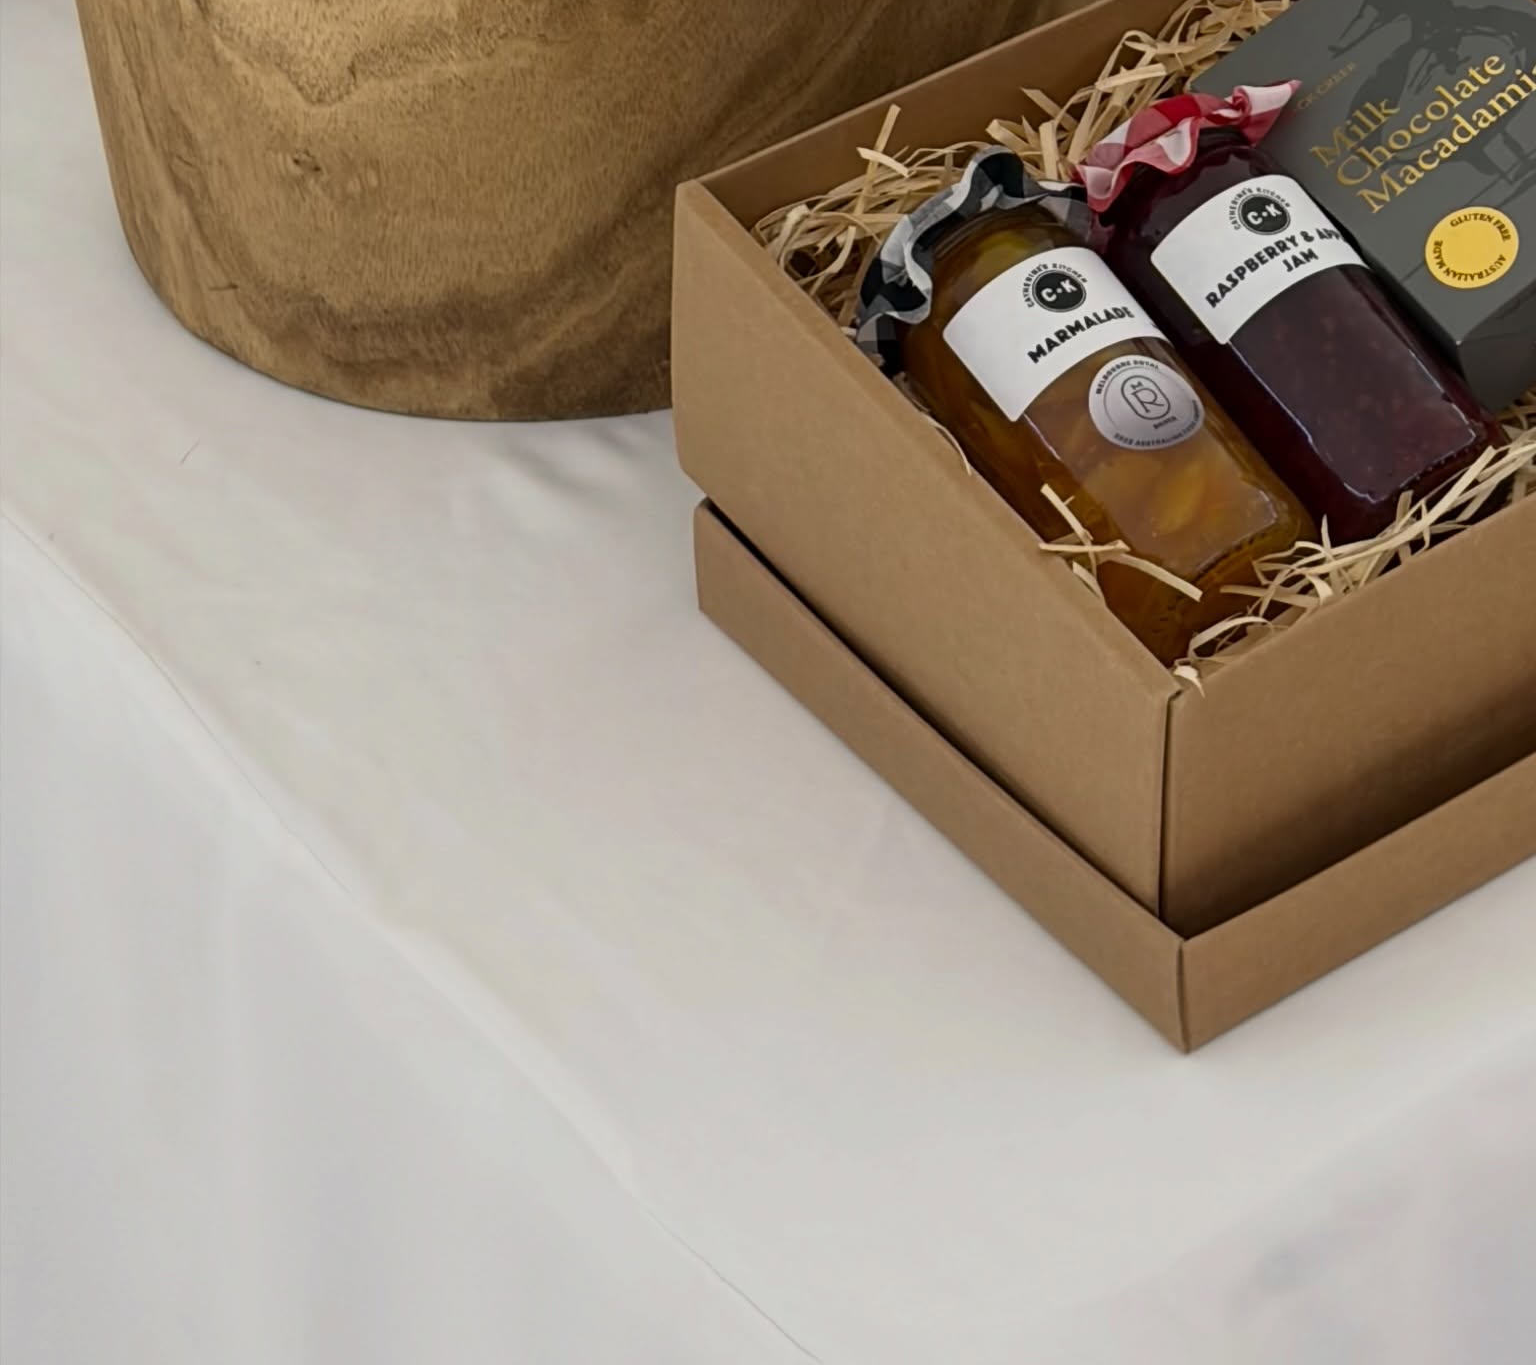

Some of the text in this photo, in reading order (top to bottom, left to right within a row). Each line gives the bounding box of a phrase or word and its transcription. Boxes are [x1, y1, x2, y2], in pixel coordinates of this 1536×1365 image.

[1308, 97, 1401, 168] Milk
[1335, 52, 1507, 186] Chocolate
[1228, 186, 1254, 231] CATHERINE'S
[1449, 212, 1512, 243] GLUTEN FREE
[1204, 226, 1344, 309] RASPBERRY & APP
[1281, 247, 1320, 273] JAM
[1432, 239, 1508, 283] AUSTRALIAN MADE
[1021, 262, 1050, 309] CATHERINE'S
[1027, 305, 1136, 365] MARMALADE
